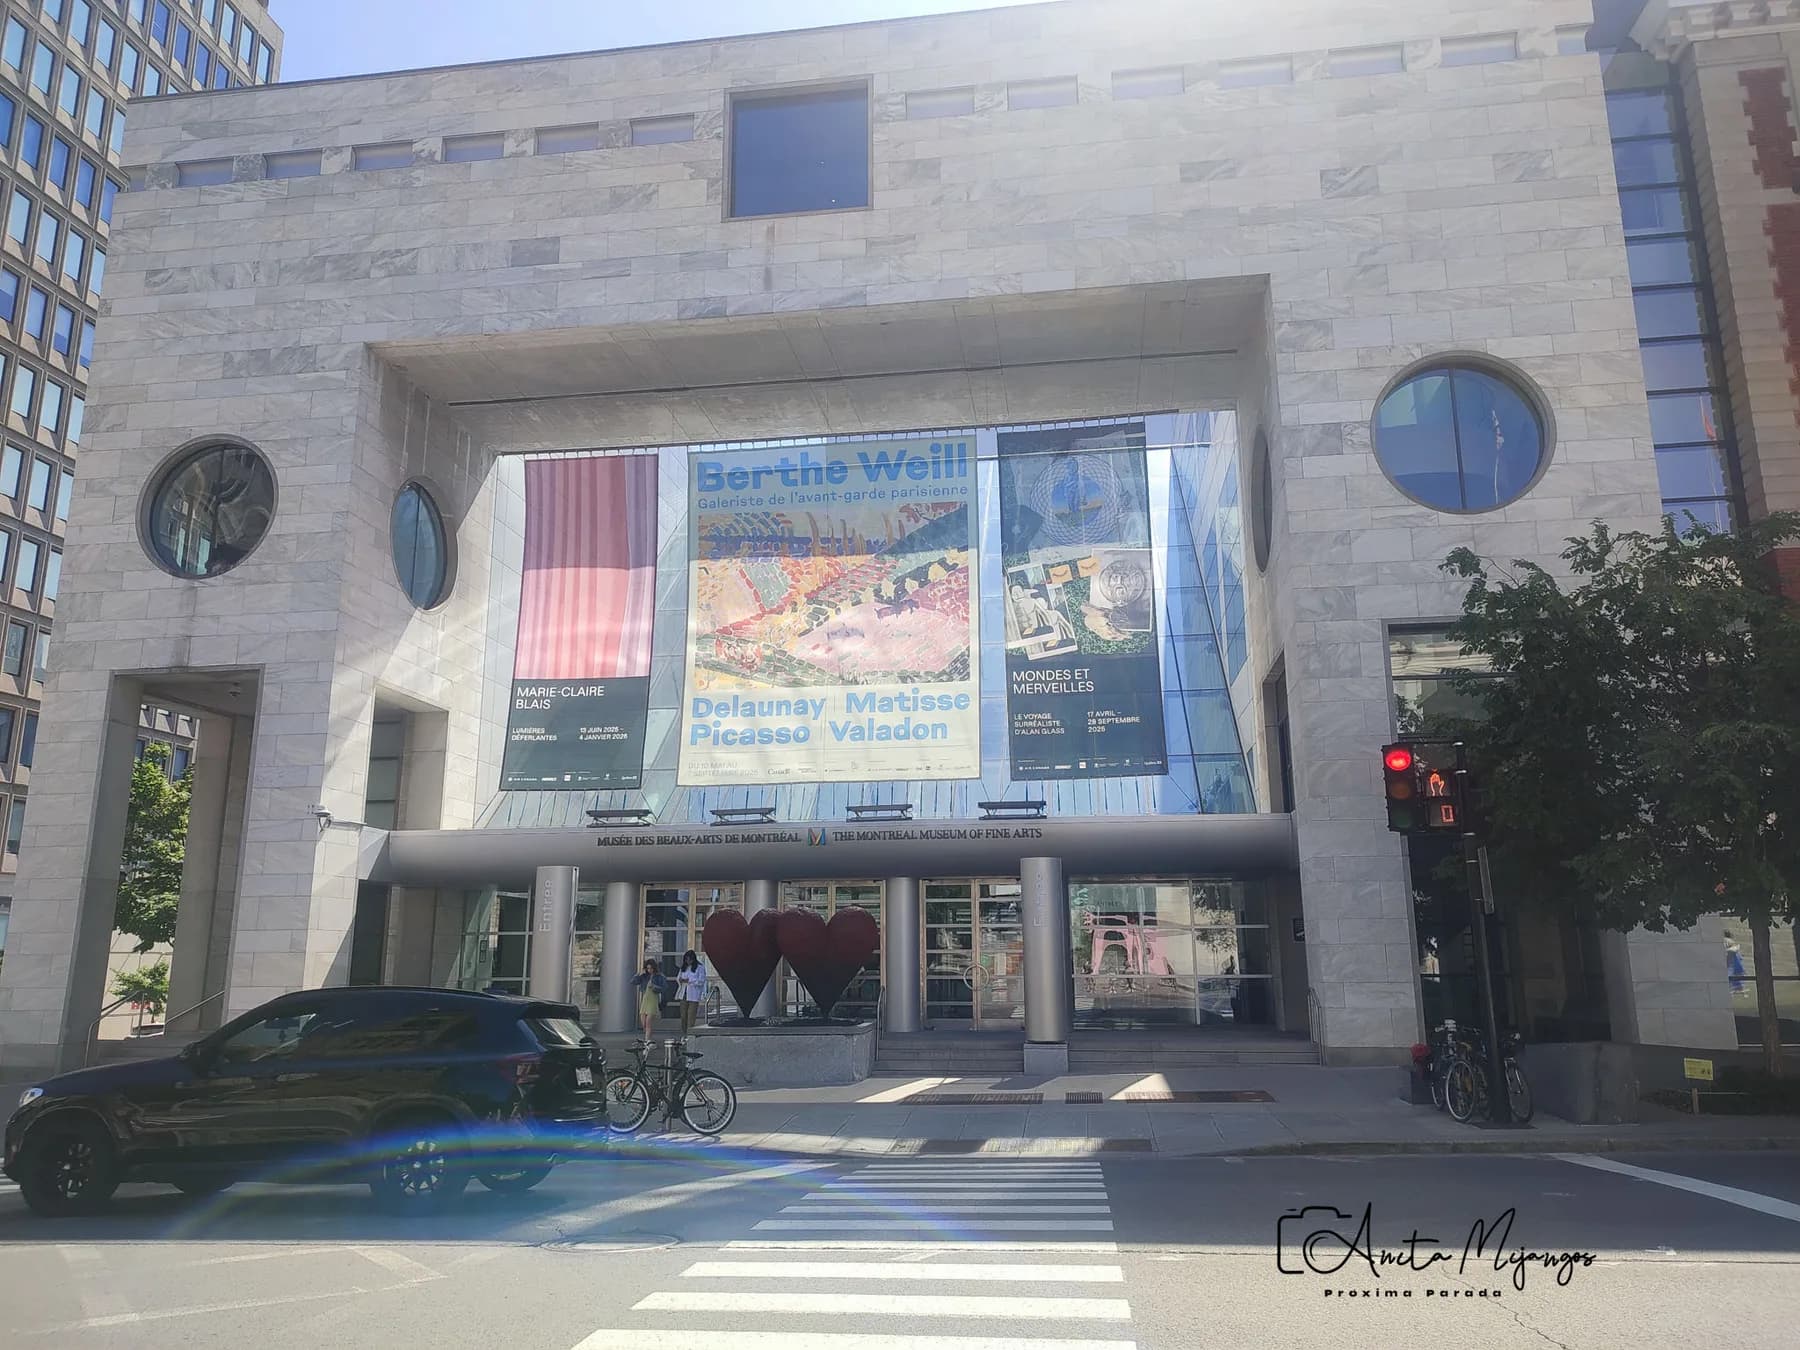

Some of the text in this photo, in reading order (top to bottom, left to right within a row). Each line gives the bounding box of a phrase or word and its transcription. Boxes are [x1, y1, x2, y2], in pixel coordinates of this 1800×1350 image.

[698, 442, 967, 492] Berthe Weill
[698, 484, 968, 510] Galeriste de l'avant-garde parisienne
[1012, 668, 1090, 682] MONDES ET
[517, 686, 605, 698] MARIE-CLAIRE
[1013, 681, 1094, 694] MERVEILLES
[515, 699, 551, 710] BLAIS
[692, 687, 970, 720] Delaunay Matisse
[1014, 712, 1052, 721] LE VOYAGE
[1098, 716, 1140, 725] SEPTEMBRE
[1014, 719, 1061, 728] SURRÉALISTE
[690, 717, 948, 746] Picasso Valadon
[597, 834, 632, 846] MUSÉE
[635, 836, 654, 846] DES
[656, 834, 722, 845] BEAUX-ARTS
[725, 834, 738, 844] DE
[741, 832, 801, 844] MONTRÉAL
[833, 831, 855, 841] THE
[856, 829, 918, 841] MONTREAL
[920, 829, 967, 840] MUSEUM
[969, 828, 983, 839] OF
[985, 828, 1010, 839] FINE
[1013, 827, 1042, 839] ARTS
